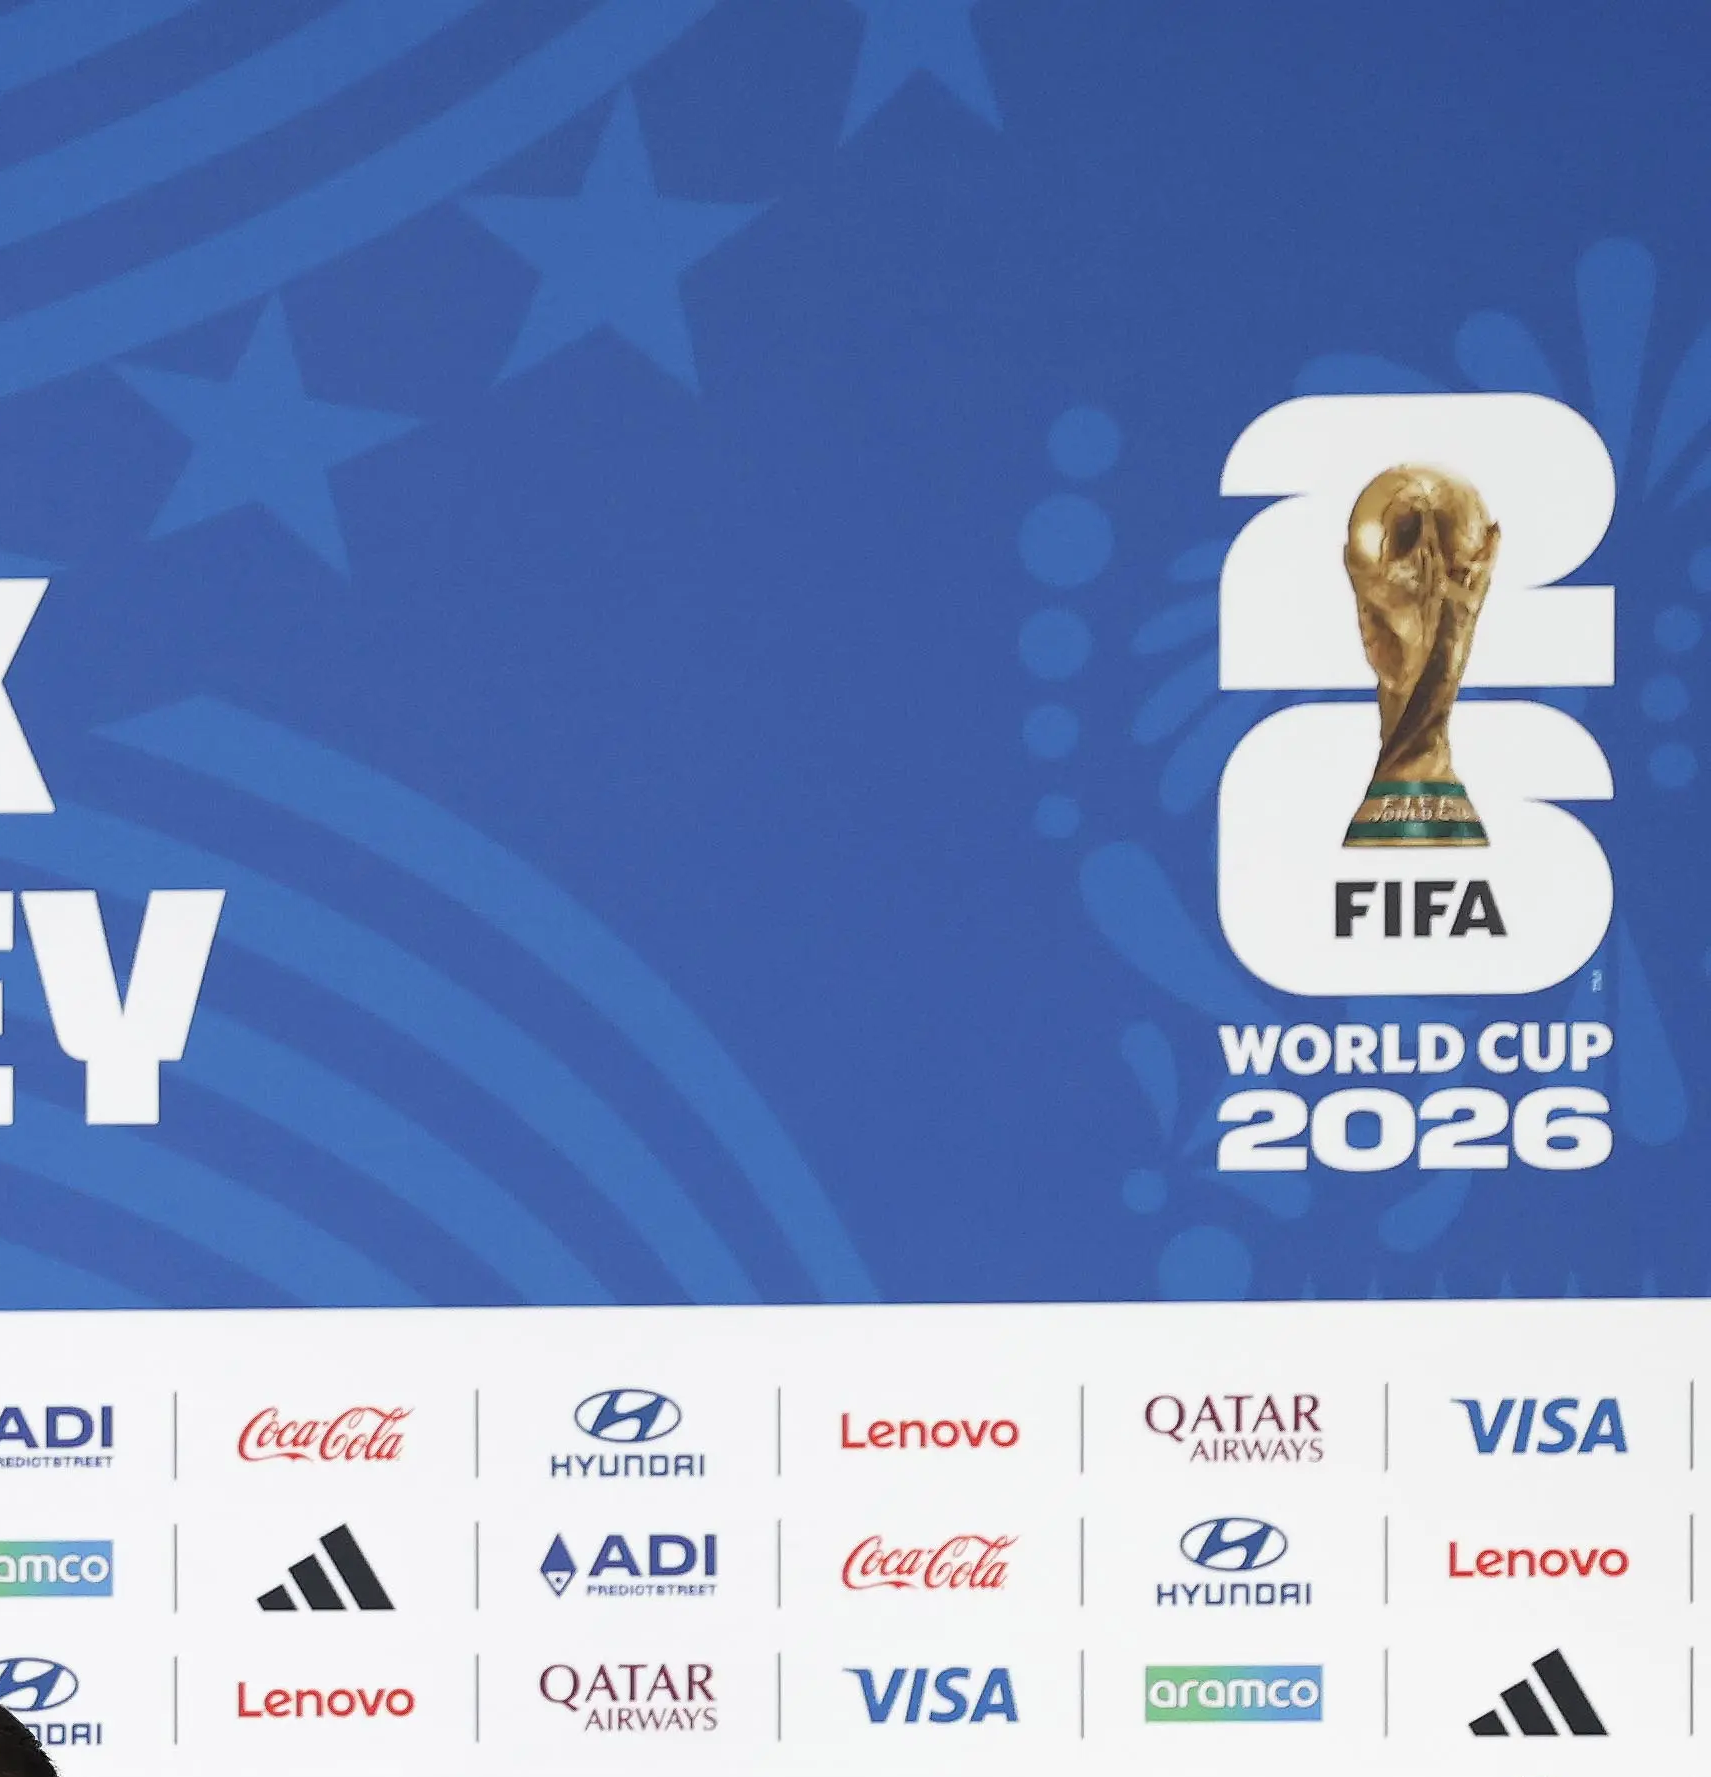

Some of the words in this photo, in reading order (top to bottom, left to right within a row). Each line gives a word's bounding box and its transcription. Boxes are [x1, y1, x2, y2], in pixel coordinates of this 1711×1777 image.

[1334, 879, 1508, 939] FIFA
[1218, 1023, 1465, 1075] WORLD
[1478, 1022, 1613, 1073] CUP
[1217, 1086, 1613, 1172] 2026
[840, 1412, 1020, 1450] Lenovo
[1144, 1393, 1321, 1441] QATAR
[1451, 1396, 1629, 1456] VISA
[550, 1453, 705, 1478] HYUNDAI
[1190, 1438, 1324, 1463] AIRWAYS
[587, 1533, 718, 1578] ADI
[1448, 1541, 1630, 1579] Lenovo
[539, 1663, 715, 1711] QATAR
[844, 1666, 1019, 1725] VISA
[584, 1707, 718, 1732] AIRWAYS
